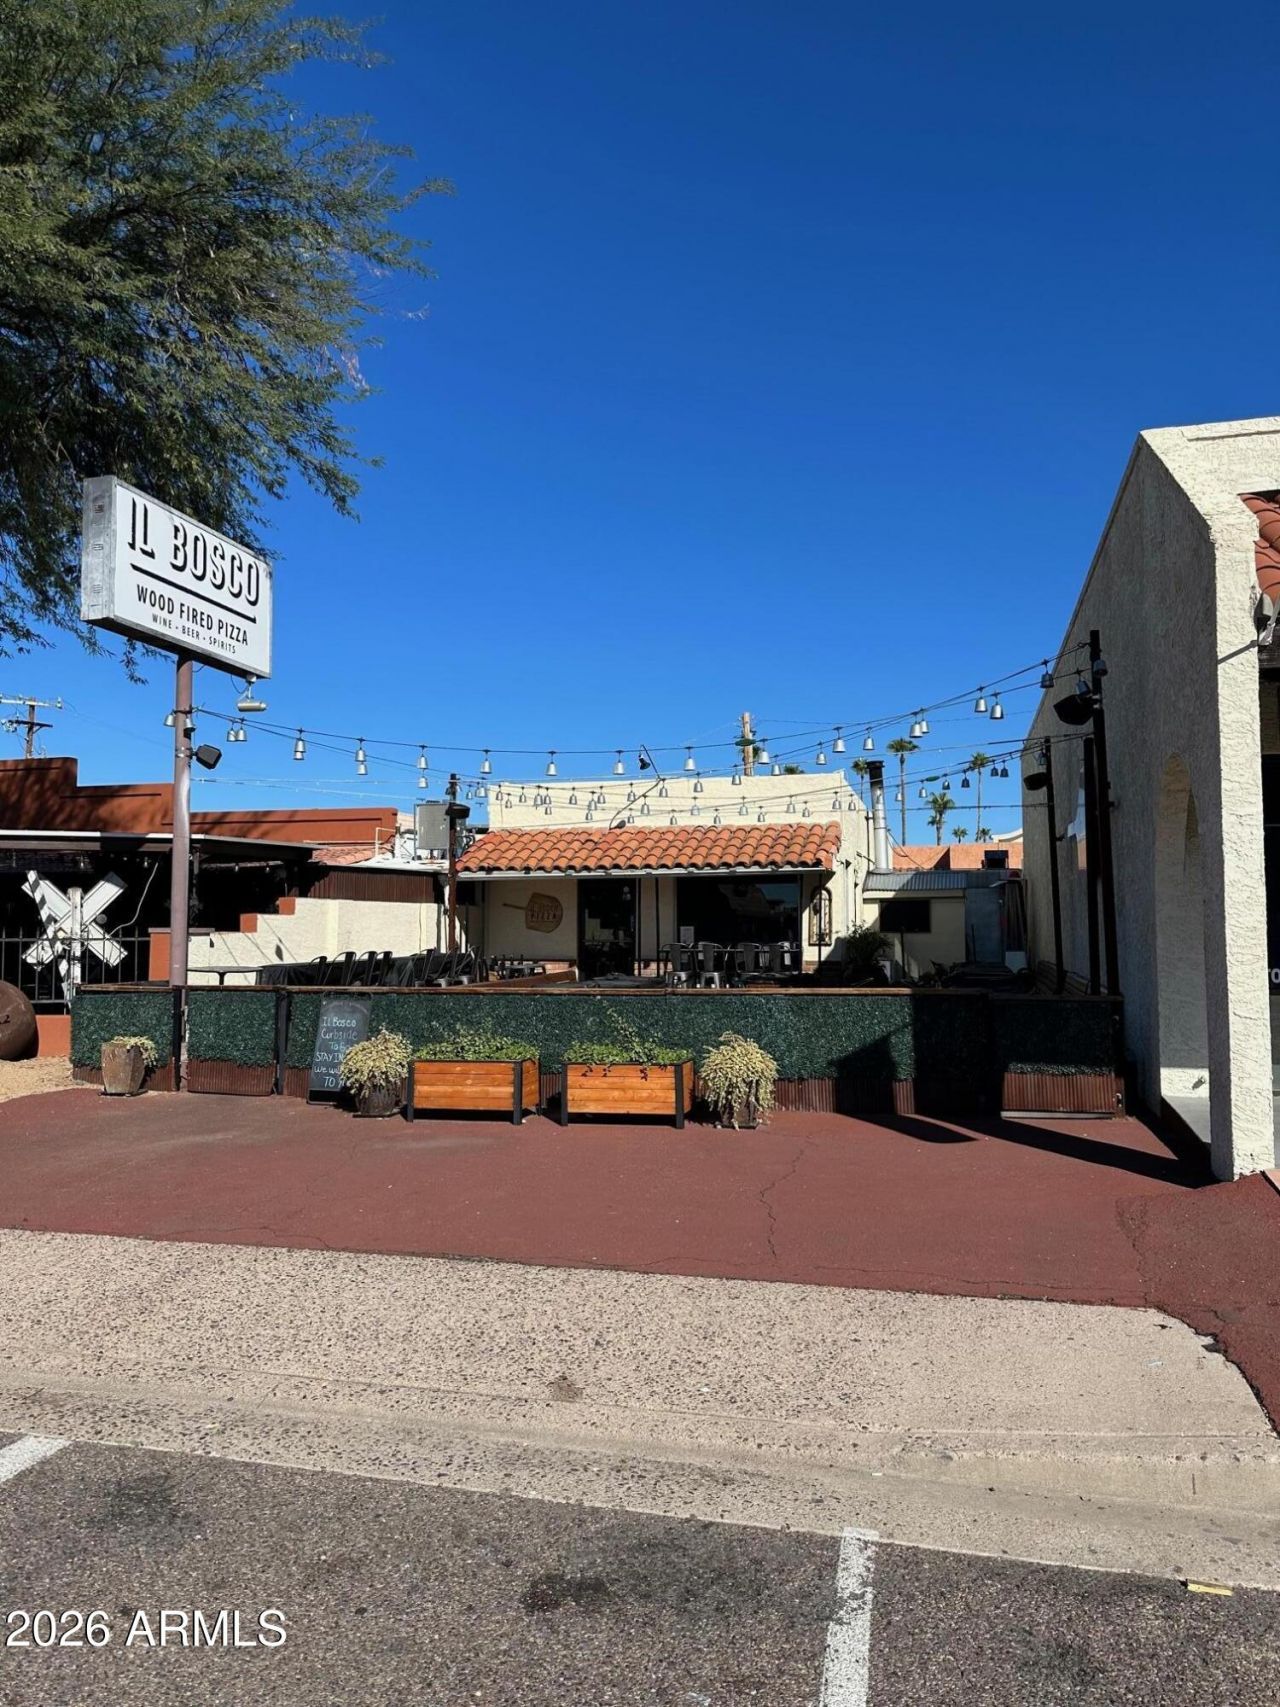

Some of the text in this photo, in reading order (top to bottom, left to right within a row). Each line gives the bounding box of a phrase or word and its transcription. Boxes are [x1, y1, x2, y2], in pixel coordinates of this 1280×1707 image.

[127, 497, 261, 607] IL BOSCO
[137, 583, 249, 646] WOOD FIRED PIZZA
[152, 613, 237, 655] WINE BEER SPIRITS
[321, 1027, 358, 1041] Curbside
